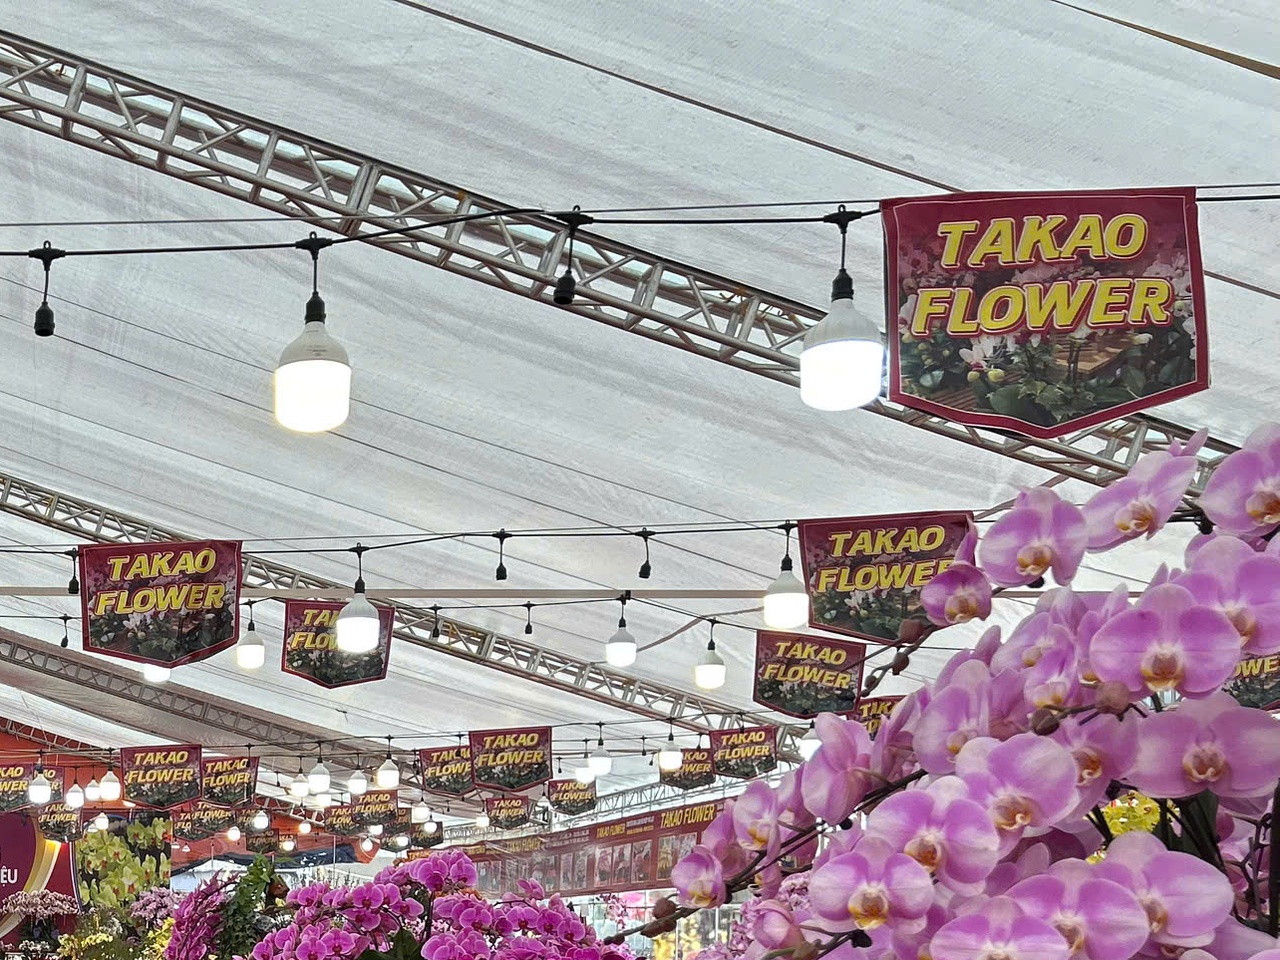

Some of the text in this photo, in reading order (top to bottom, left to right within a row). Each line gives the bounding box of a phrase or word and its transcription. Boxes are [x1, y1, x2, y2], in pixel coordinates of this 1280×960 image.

[937, 213, 1148, 268] TAKAO
[911, 277, 1176, 337] FLOWER
[829, 525, 946, 558] TAKAO
[108, 548, 216, 581] TAKAO
[94, 582, 225, 616] FLOWER
[775, 641, 847, 666] TAKAO
[762, 664, 852, 690] FLOWER
[483, 733, 539, 749] TAKAO
[721, 731, 766, 745] TAKAO
[134, 751, 189, 766] TAKAO
[478, 750, 544, 767] FLOWER
[684, 752, 708, 760] KAO
[717, 745, 769, 760] FLOWER
[128, 768, 194, 784] FLOWER
[426, 763, 471, 777] FLOWE
[359, 794, 390, 803] TAKAO
[494, 800, 522, 808] TAKAO
[552, 792, 593, 801] FLOWER
[355, 804, 393, 814] FLOWER
[490, 808, 524, 817] FLOWER
[661, 810, 683, 828] TAKAO
[684, 804, 715, 824] FLOWER
[39, 813, 77, 822] FLOWER
